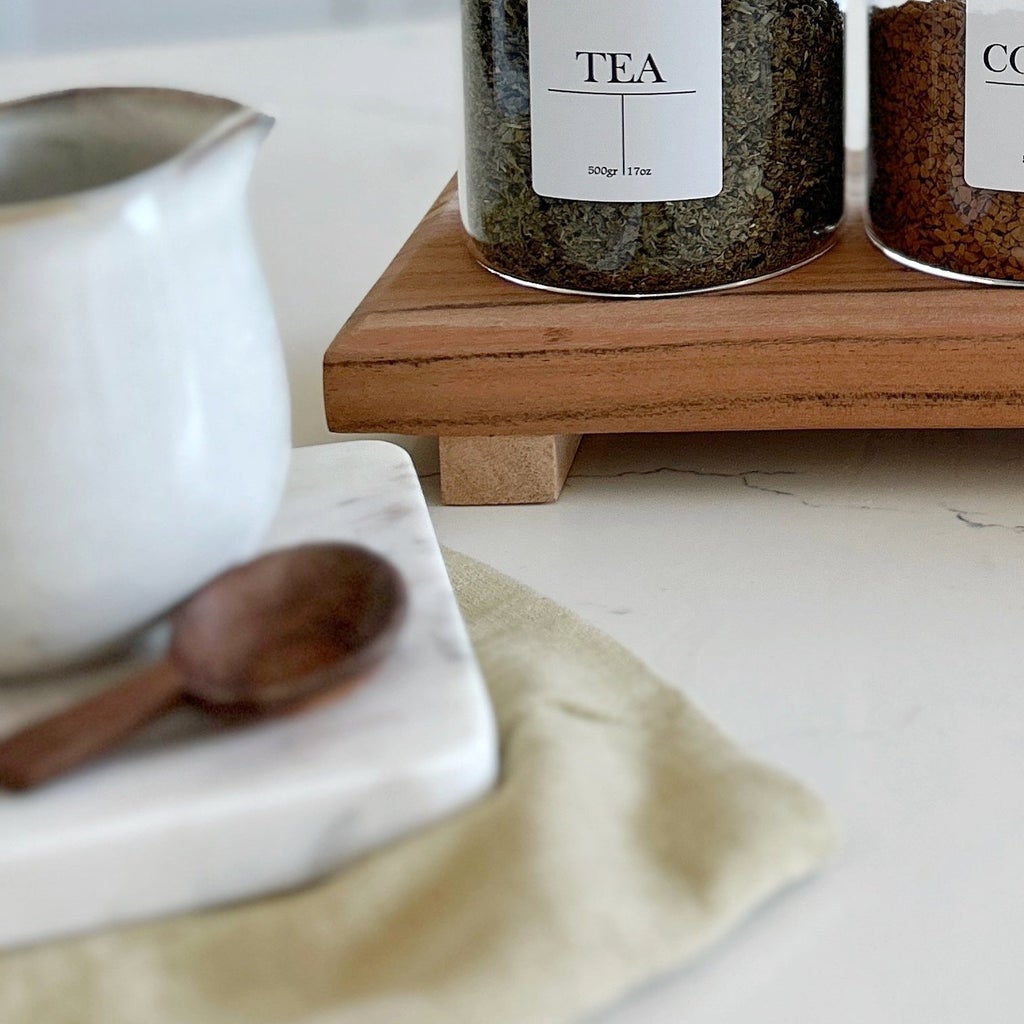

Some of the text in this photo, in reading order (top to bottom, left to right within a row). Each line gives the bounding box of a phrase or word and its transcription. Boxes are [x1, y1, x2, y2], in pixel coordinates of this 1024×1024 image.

[575, 50, 668, 84] TEA
[587, 165, 653, 179] 500gr 17oz
